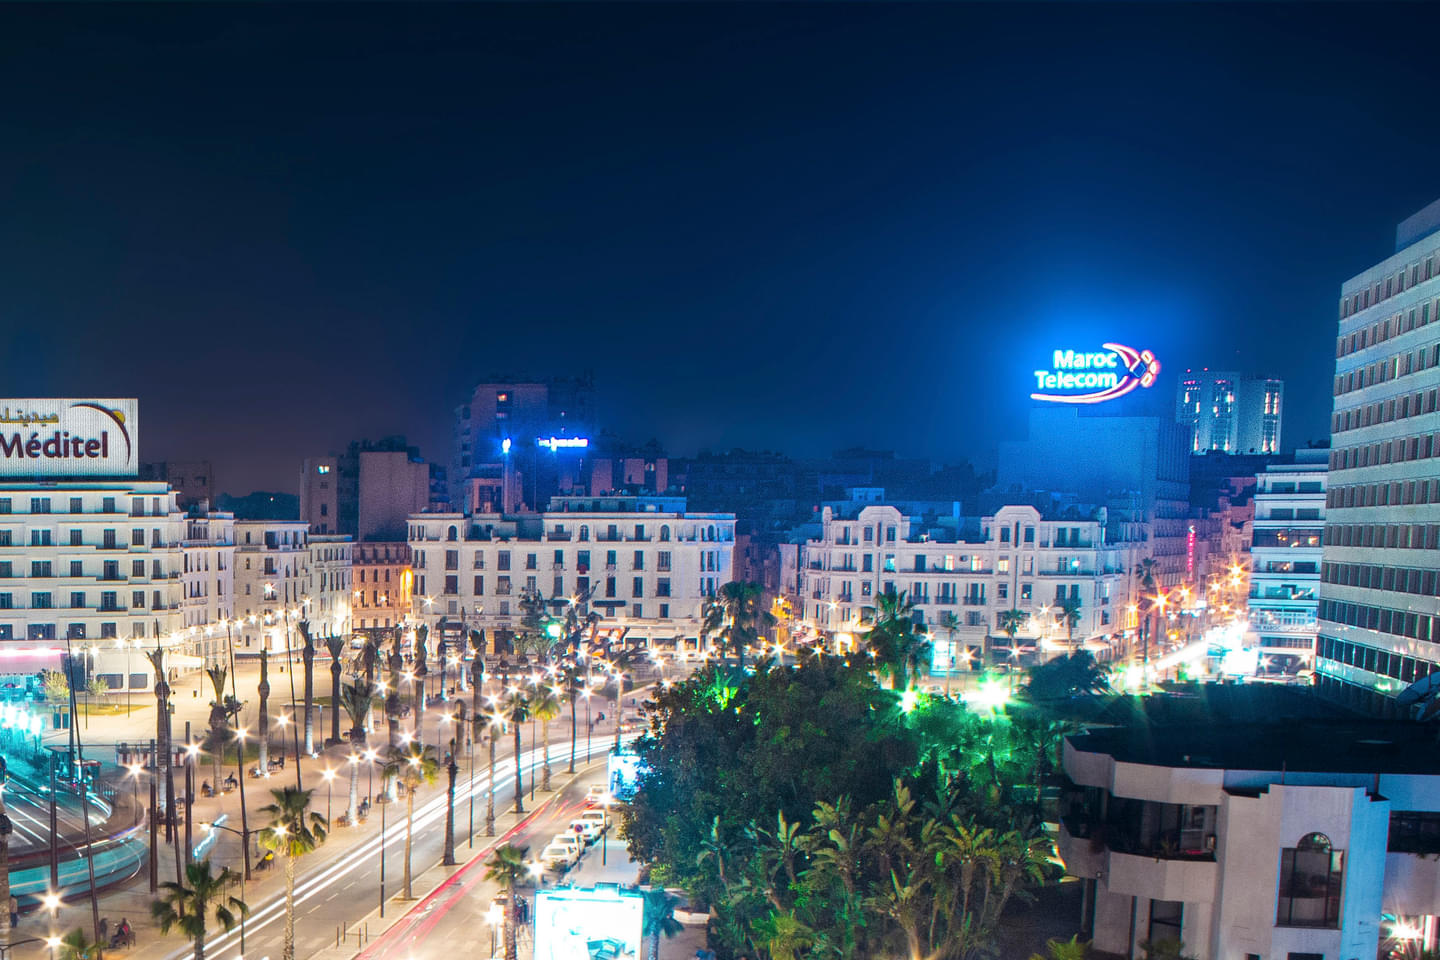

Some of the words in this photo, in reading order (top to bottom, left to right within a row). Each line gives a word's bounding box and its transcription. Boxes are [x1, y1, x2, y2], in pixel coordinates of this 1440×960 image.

[1053, 350, 1118, 369] Maroc
[1034, 370, 1118, 390] Telecom
[0, 407, 59, 427] ميديتل
